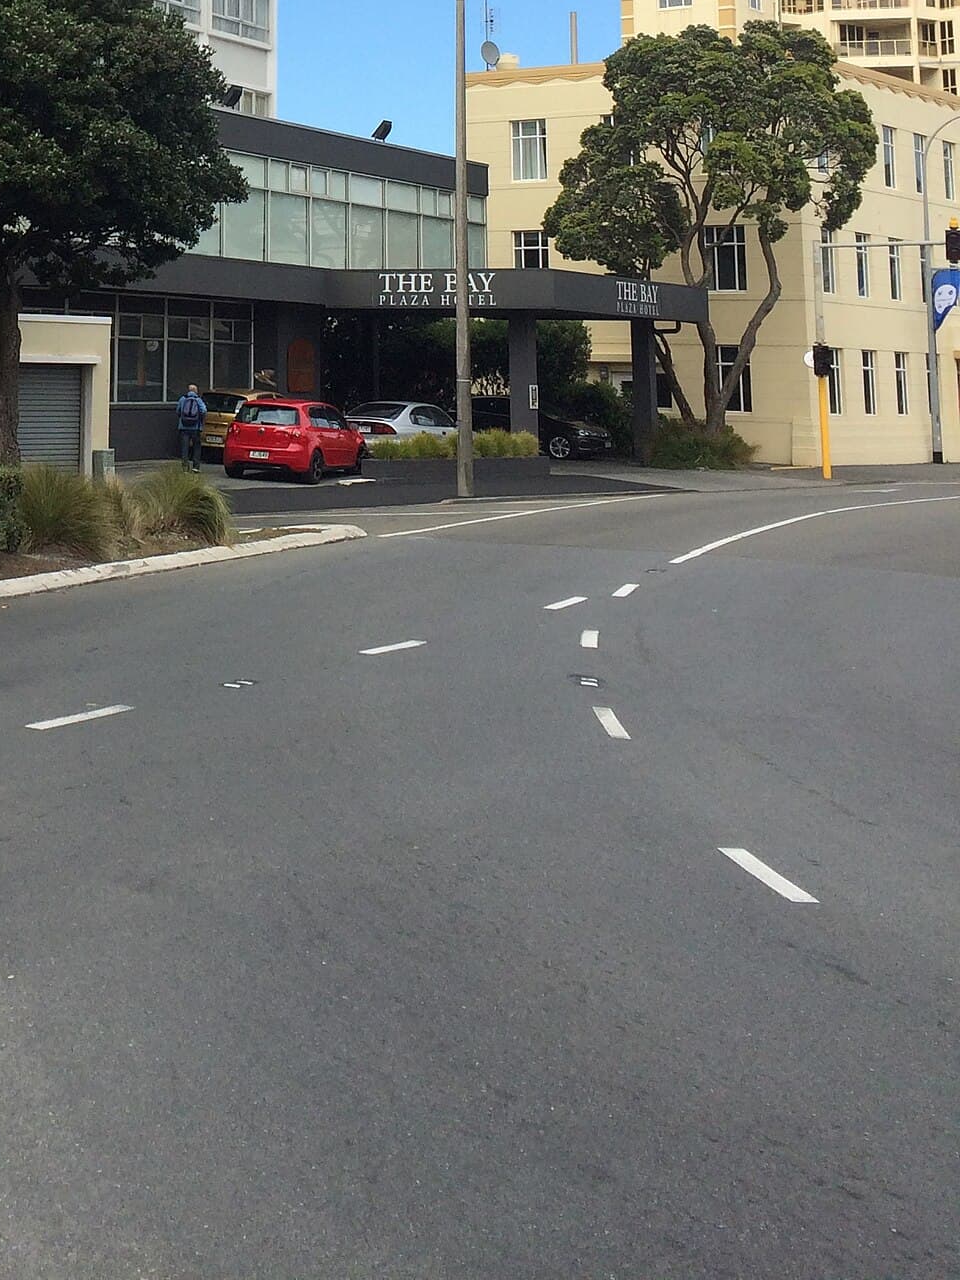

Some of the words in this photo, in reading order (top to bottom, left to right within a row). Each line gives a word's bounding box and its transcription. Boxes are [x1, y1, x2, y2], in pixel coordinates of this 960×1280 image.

[379, 273, 434, 293] THE
[616, 281, 638, 301] THE
[640, 284, 659, 304] BAY
[379, 295, 430, 306] PLAZA
[441, 295, 497, 306] HTEL
